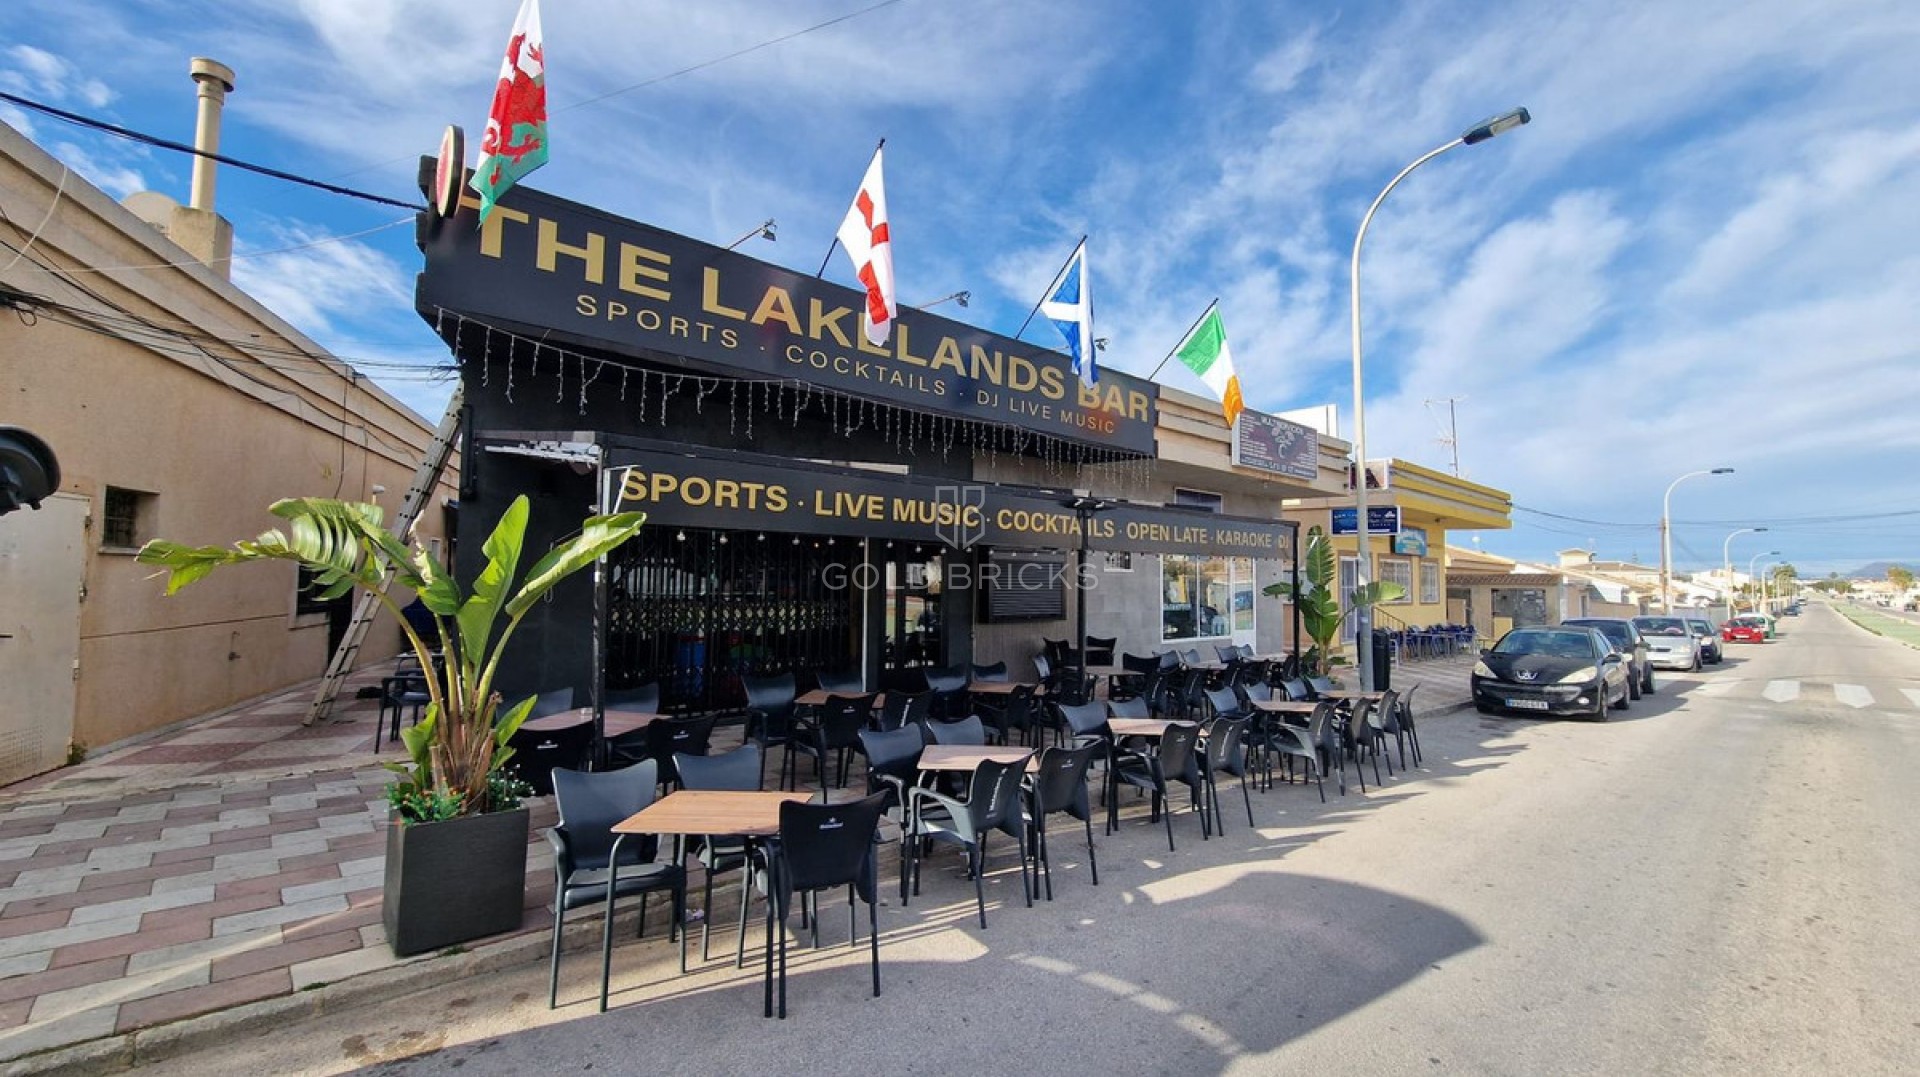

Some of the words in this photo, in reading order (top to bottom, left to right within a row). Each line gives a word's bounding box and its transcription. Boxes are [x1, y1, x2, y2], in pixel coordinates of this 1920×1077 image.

[459, 195, 672, 302] THE
[1078, 379, 1148, 422] BAR
[575, 294, 738, 348] SPORTS
[786, 344, 946, 396] COCKTAILS
[977, 389, 998, 408] DJ
[1009, 397, 1051, 419] LIVE
[1060, 411, 1114, 434] MUSIC
[620, 469, 788, 512] SPORTS
[815, 489, 884, 520] LIVE
[893, 497, 980, 527] MUSIC
[997, 509, 1115, 538] COCKTAILS
[1126, 521, 1169, 542] OPEN
[1173, 525, 1208, 544] LATE
[1216, 529, 1272, 548] KARAOKE
